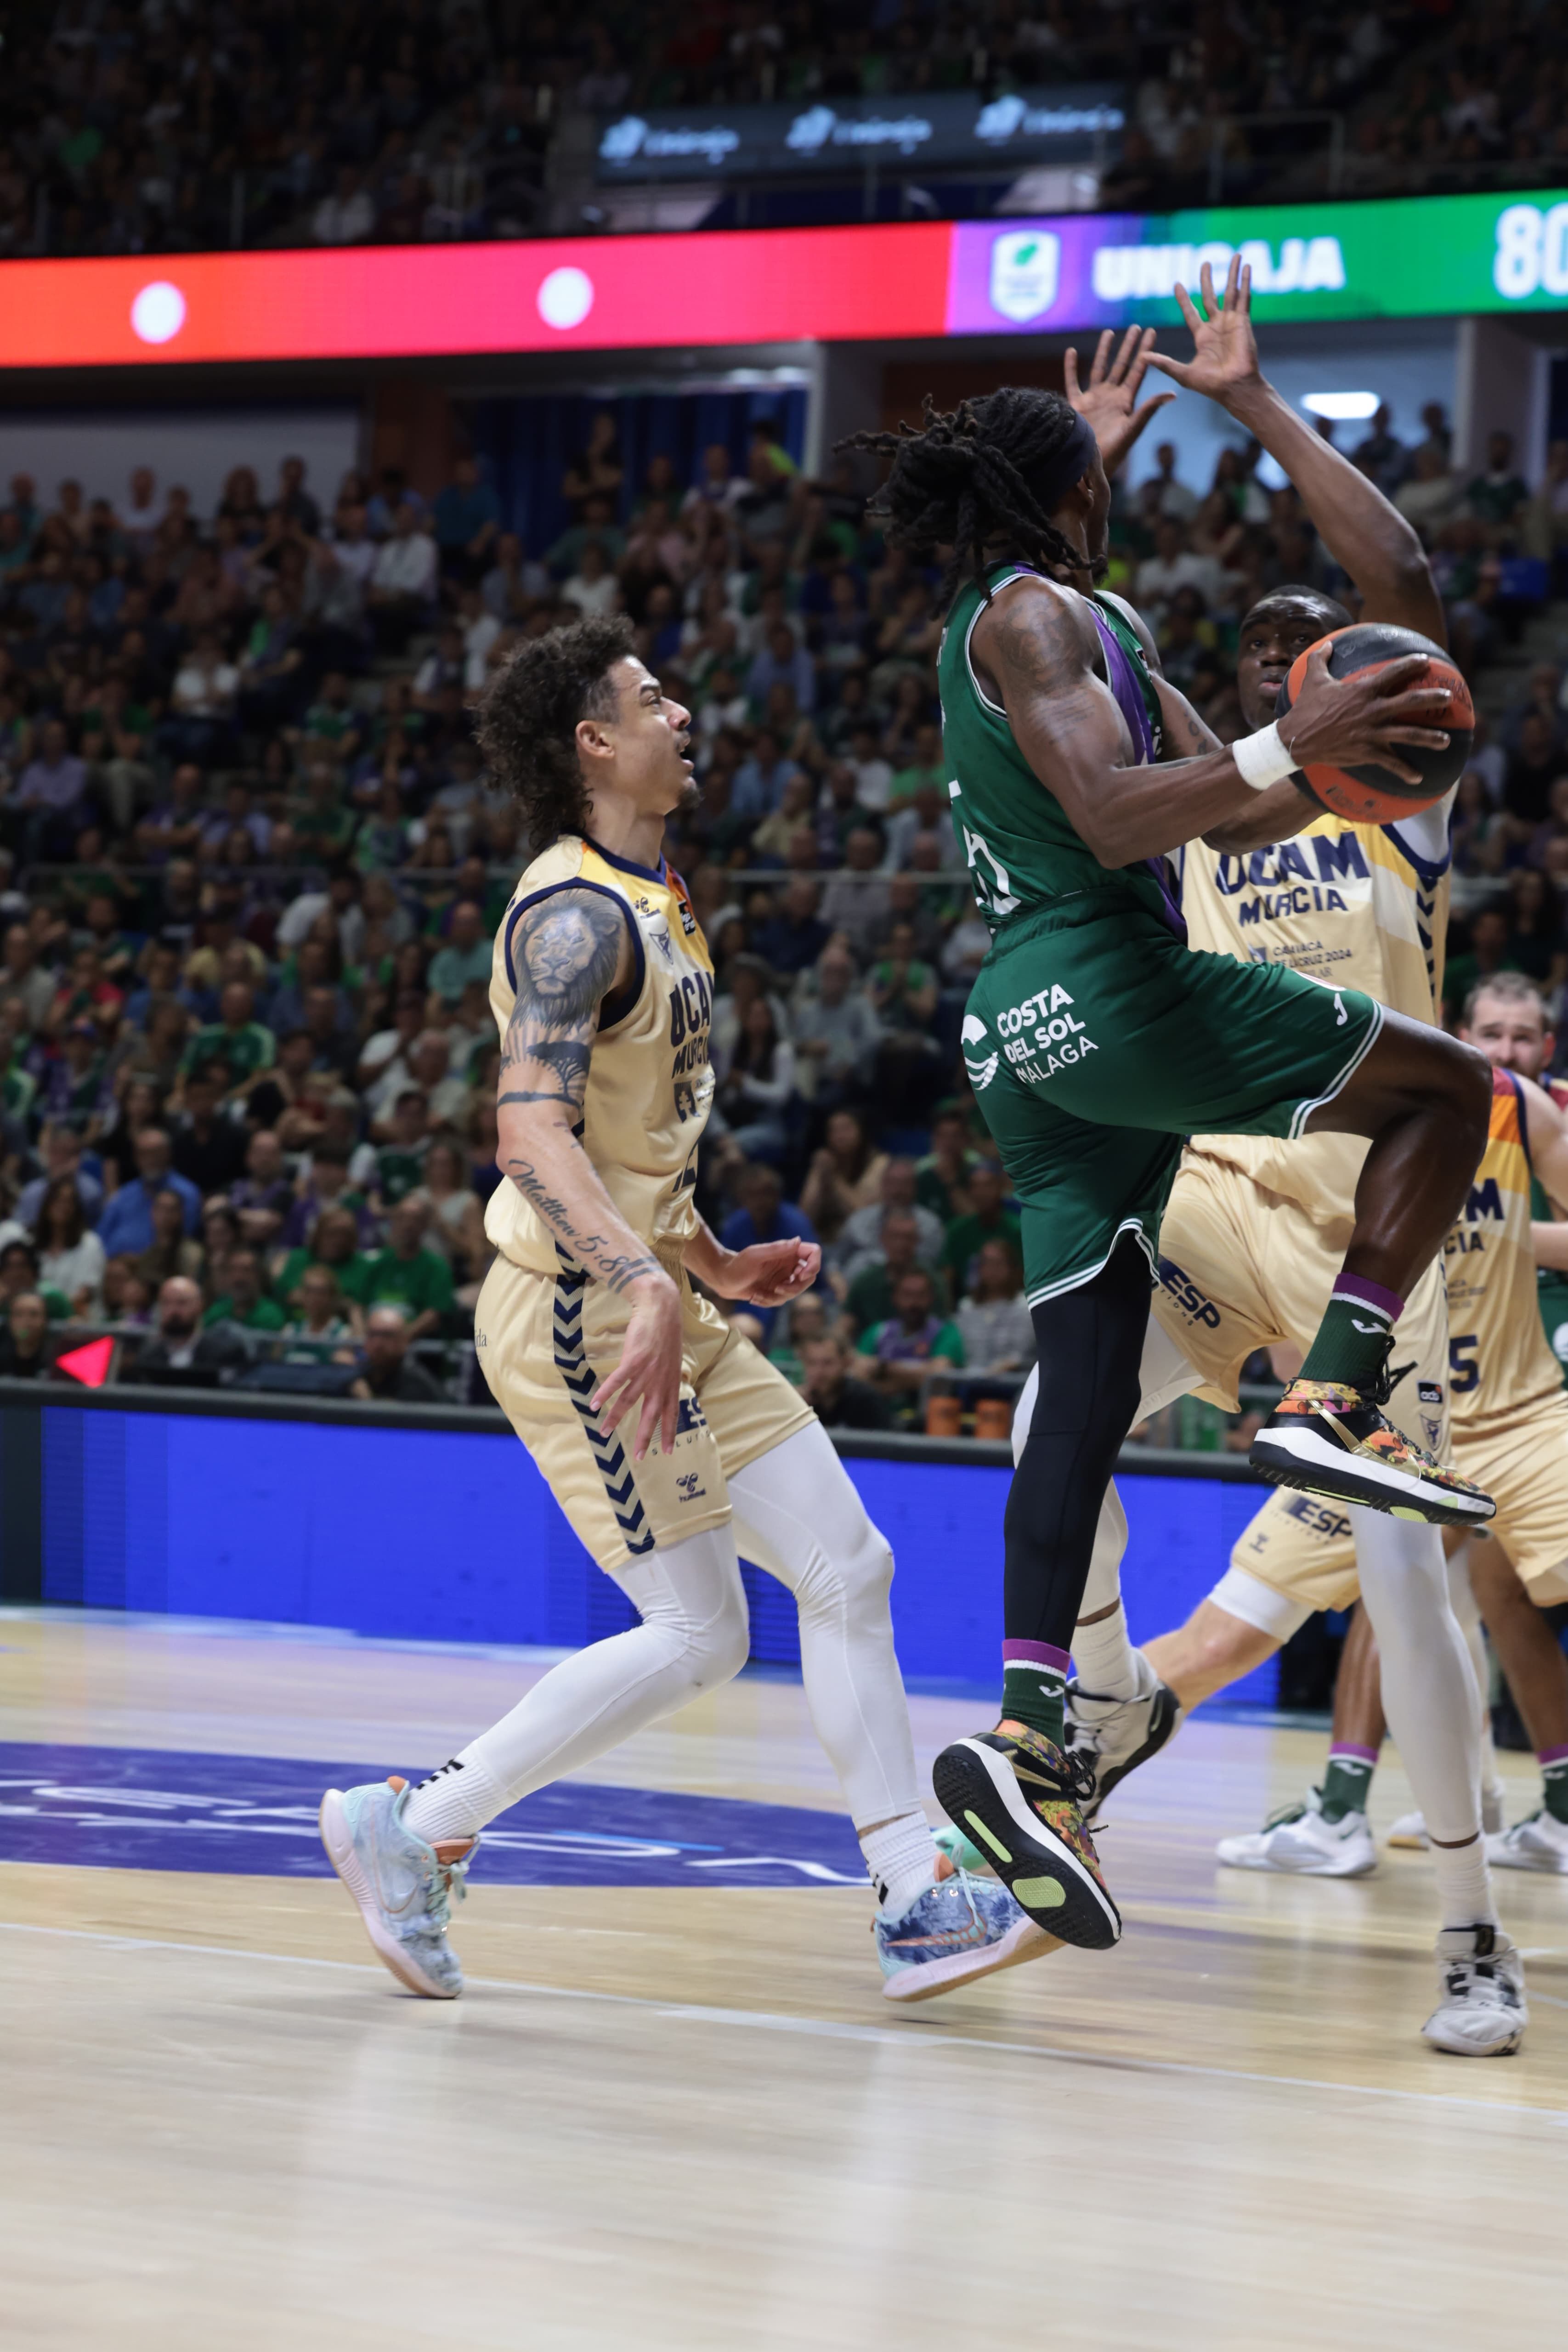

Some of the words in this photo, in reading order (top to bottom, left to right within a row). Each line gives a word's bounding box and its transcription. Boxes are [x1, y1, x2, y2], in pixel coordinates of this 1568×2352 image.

[1092, 235, 1347, 302] UNICAJA
[1216, 831, 1371, 896] UCAM
[669, 971, 715, 1048] UCA
[997, 984, 1075, 1038] COSTA
[671, 1036, 709, 1080] MURCI
[1003, 1037, 1036, 1063] DEL
[1034, 1012, 1086, 1049] SOL
[1015, 1035, 1099, 1084] MÁLAGA
[1444, 1231, 1485, 1255] CIA
